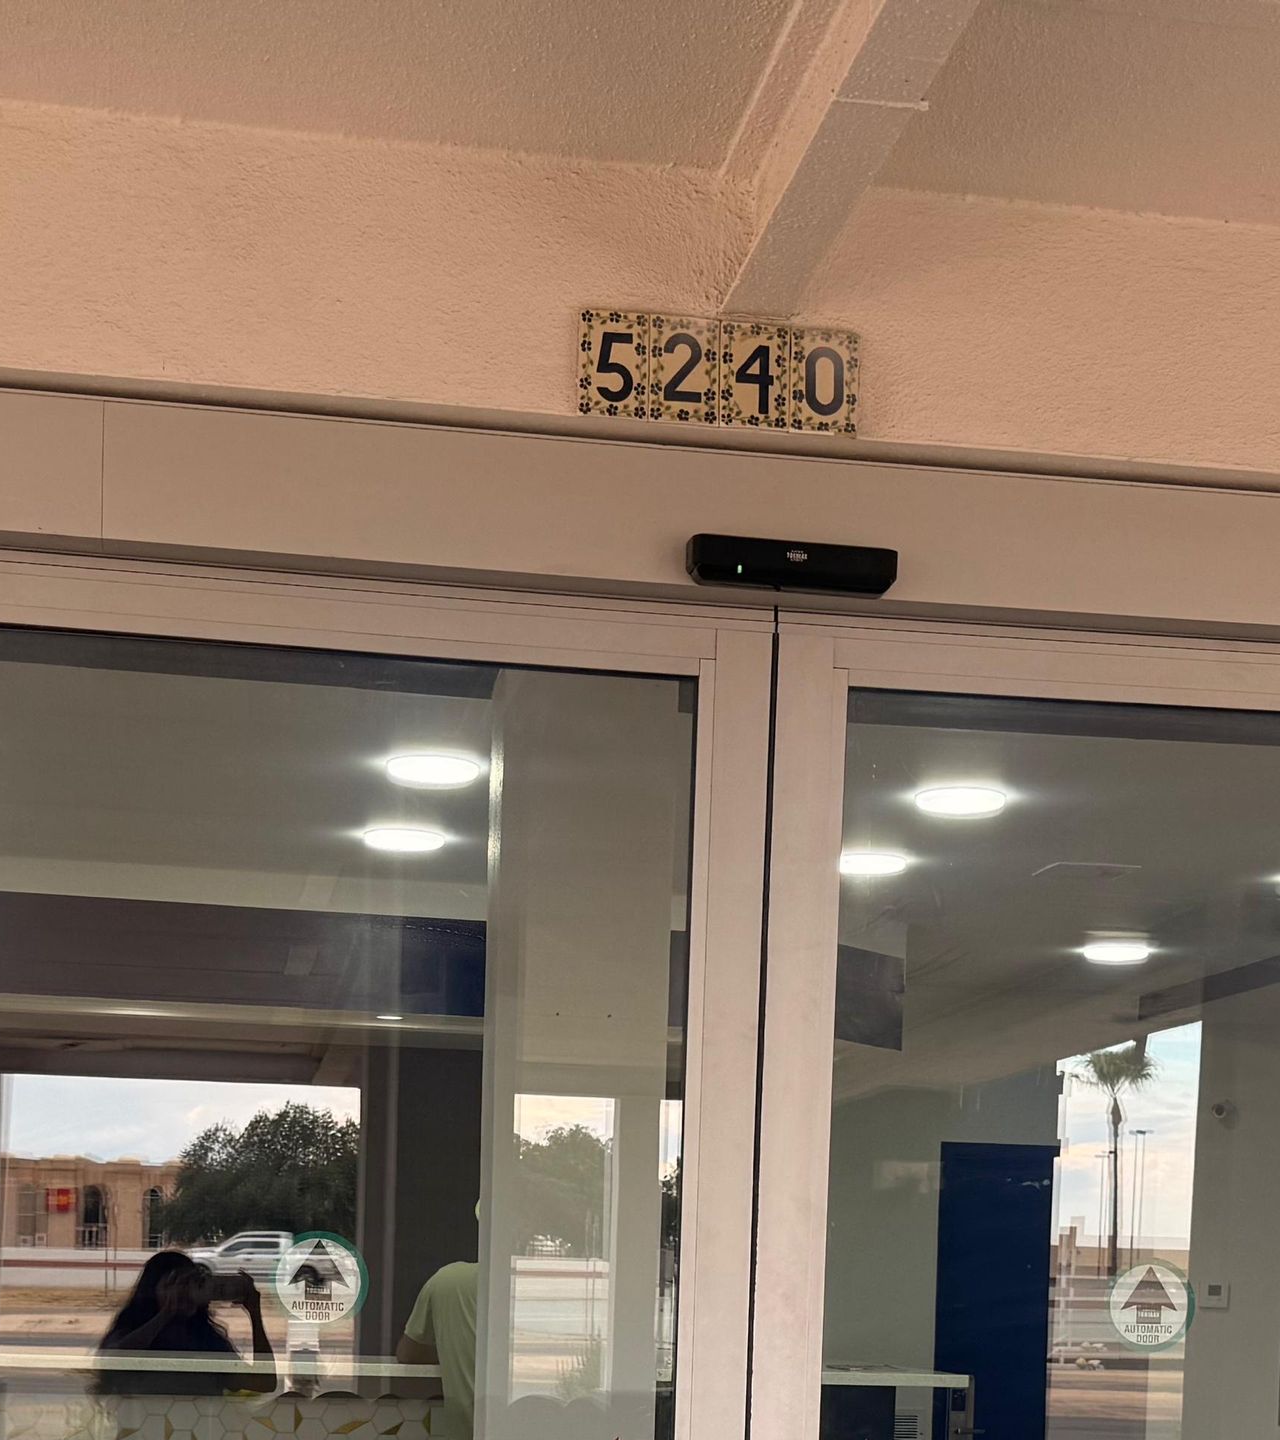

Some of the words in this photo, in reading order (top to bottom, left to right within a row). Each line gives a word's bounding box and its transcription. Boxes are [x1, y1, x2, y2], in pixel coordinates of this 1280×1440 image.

[596, 331, 845, 416] 5240
[291, 1300, 345, 1311] AUTOMATIC
[305, 1311, 330, 1321] DOOR
[1124, 1324, 1173, 1334] AUTOMATIC
[1136, 1334, 1160, 1344] DOOR
